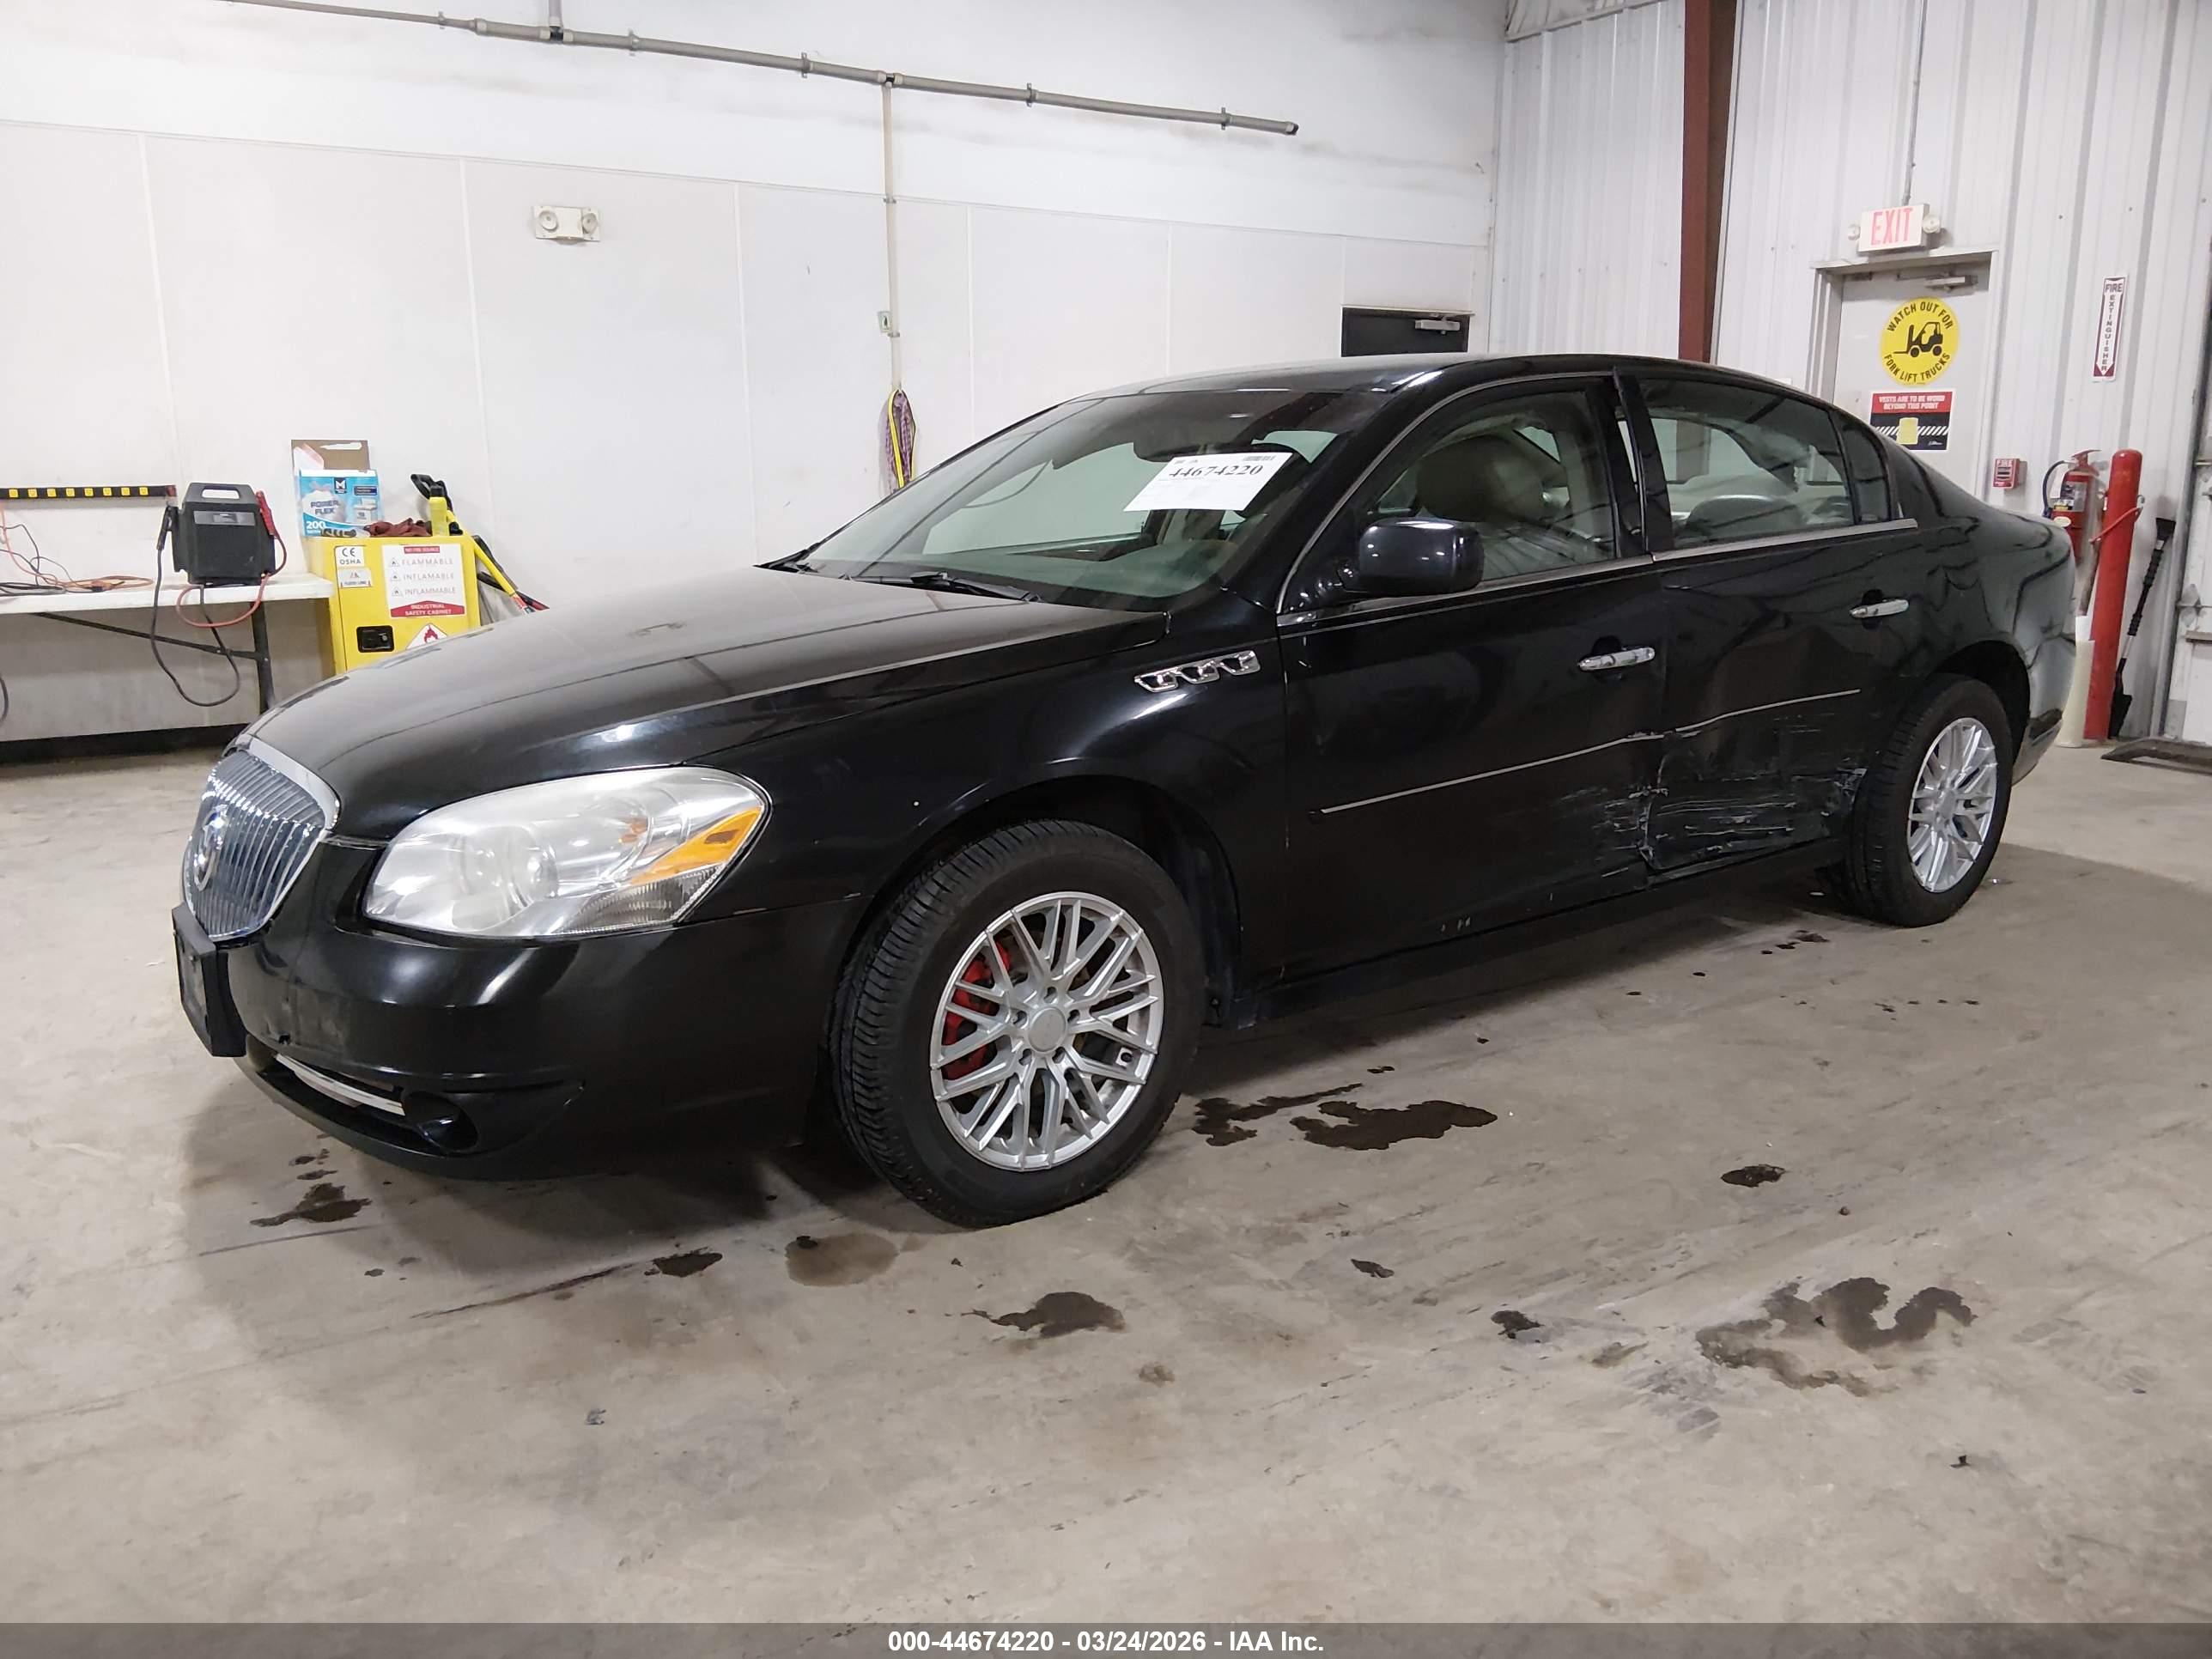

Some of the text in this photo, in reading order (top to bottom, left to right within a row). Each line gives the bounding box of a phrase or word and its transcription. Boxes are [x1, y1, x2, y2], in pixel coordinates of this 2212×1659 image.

[1871, 207, 1913, 246] EXIT
[2105, 283, 2123, 293] FIRE
[1887, 301, 1954, 331] WATCH OUT FOR
[2101, 295, 2116, 371] EXTINGUISHER
[1884, 353, 1950, 382] FORK LIFT TRUCKS
[1169, 465, 1264, 477] 44674220
[307, 520, 325, 529] 200
[342, 547, 356, 557] CE
